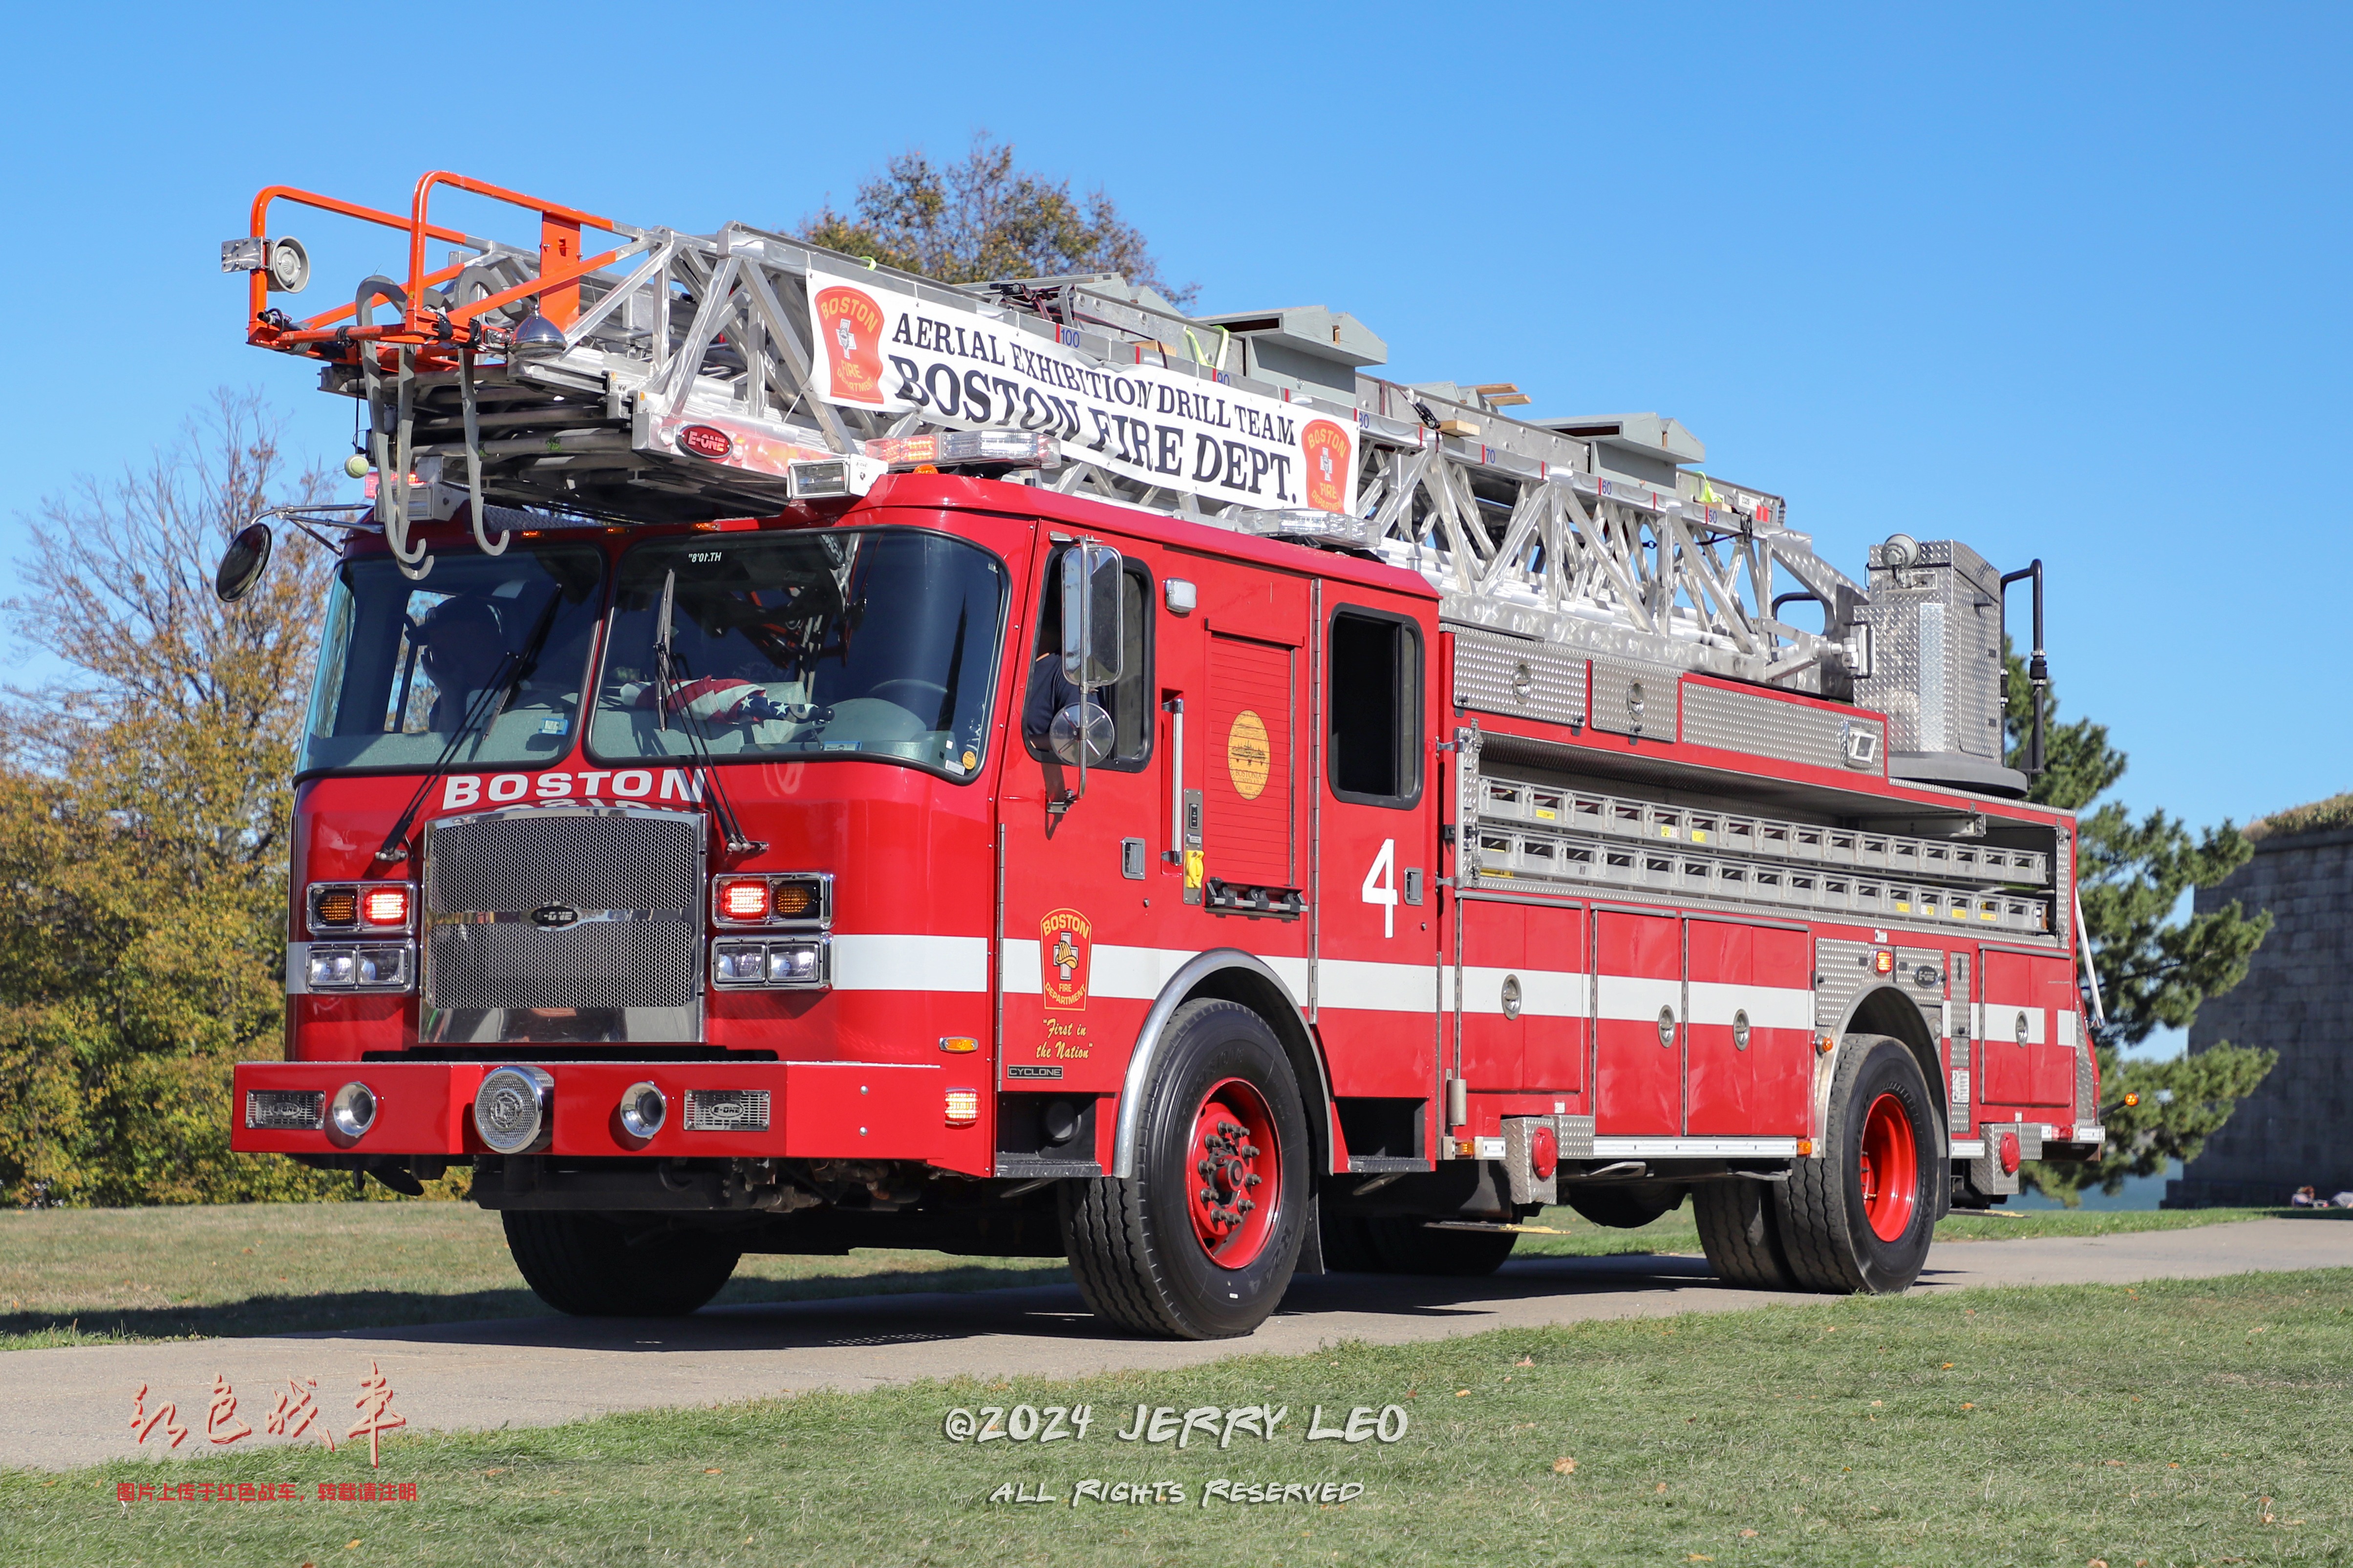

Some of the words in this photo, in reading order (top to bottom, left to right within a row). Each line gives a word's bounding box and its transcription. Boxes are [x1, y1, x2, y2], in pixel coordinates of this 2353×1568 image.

[820, 296, 878, 333] BOSTON
[1060, 328, 1080, 349] 100
[836, 367, 875, 393] DEPARTMENT
[840, 359, 863, 380] FIRE
[892, 313, 1005, 367] AERIAL
[1009, 341, 1154, 410] EXHIBITION
[1156, 384, 1231, 429] DRILL
[1234, 404, 1297, 447] TEAM
[888, 354, 1081, 442] BOSTON
[1087, 406, 1184, 477] FIRE
[1192, 433, 1298, 504] DEPT.
[687, 430, 726, 453] E-ONE
[1307, 427, 1347, 459] BOSTON
[1486, 448, 1496, 464] 70
[1319, 482, 1337, 500] FIRE
[1602, 481, 1612, 495] 60
[1311, 489, 1342, 511] DEPARTMEN
[1709, 509, 1718, 524] 50
[442, 768, 707, 811] BOSTON
[1361, 838, 1399, 939] 4
[537, 911, 573, 921] -ONE
[1042, 913, 1090, 940] BOSTON
[1045, 981, 1086, 1005] DEPARTMENT
[1058, 983, 1072, 993] FIRE
[1043, 1017, 1074, 1039] "First
[1076, 1023, 1087, 1037] in
[1036, 1040, 1051, 1059] the
[1054, 1040, 1093, 1060] Nation"
[1009, 1068, 1062, 1076] CYCLONE
